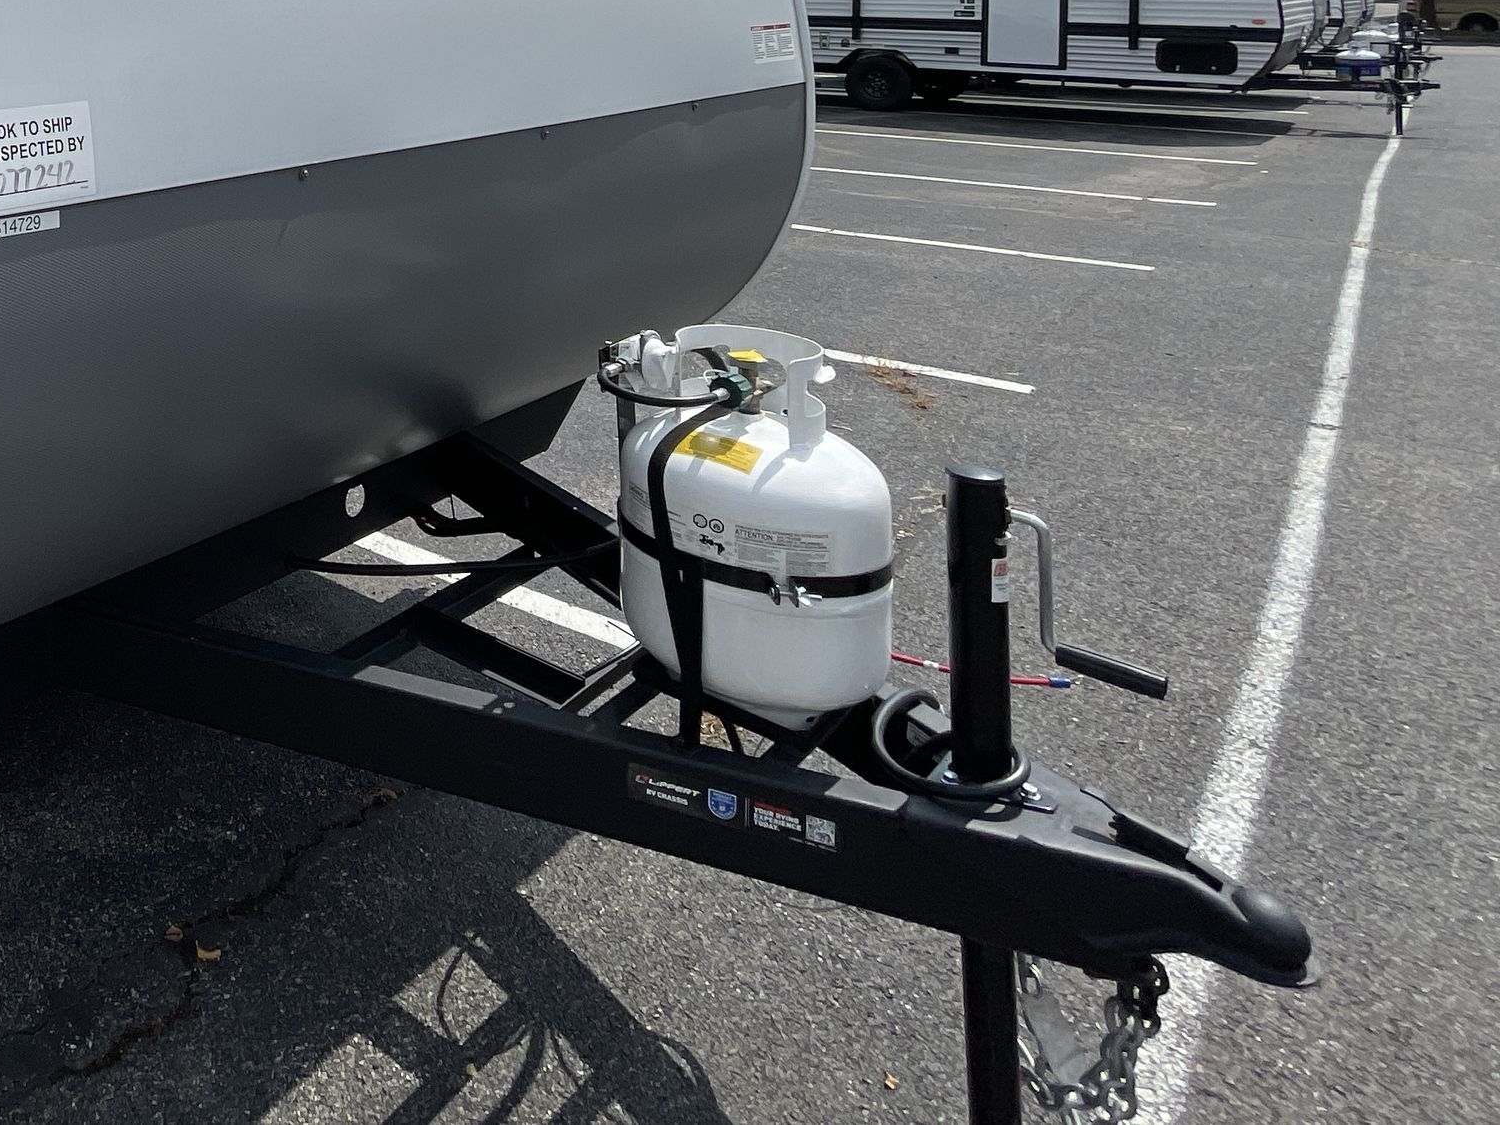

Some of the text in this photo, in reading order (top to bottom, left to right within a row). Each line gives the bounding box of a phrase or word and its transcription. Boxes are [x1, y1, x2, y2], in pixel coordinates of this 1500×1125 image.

[20, 120, 39, 136] TO
[43, 116, 73, 133] SHIP
[68, 136, 86, 152] BY
[657, 791, 689, 806] CHASSIS
